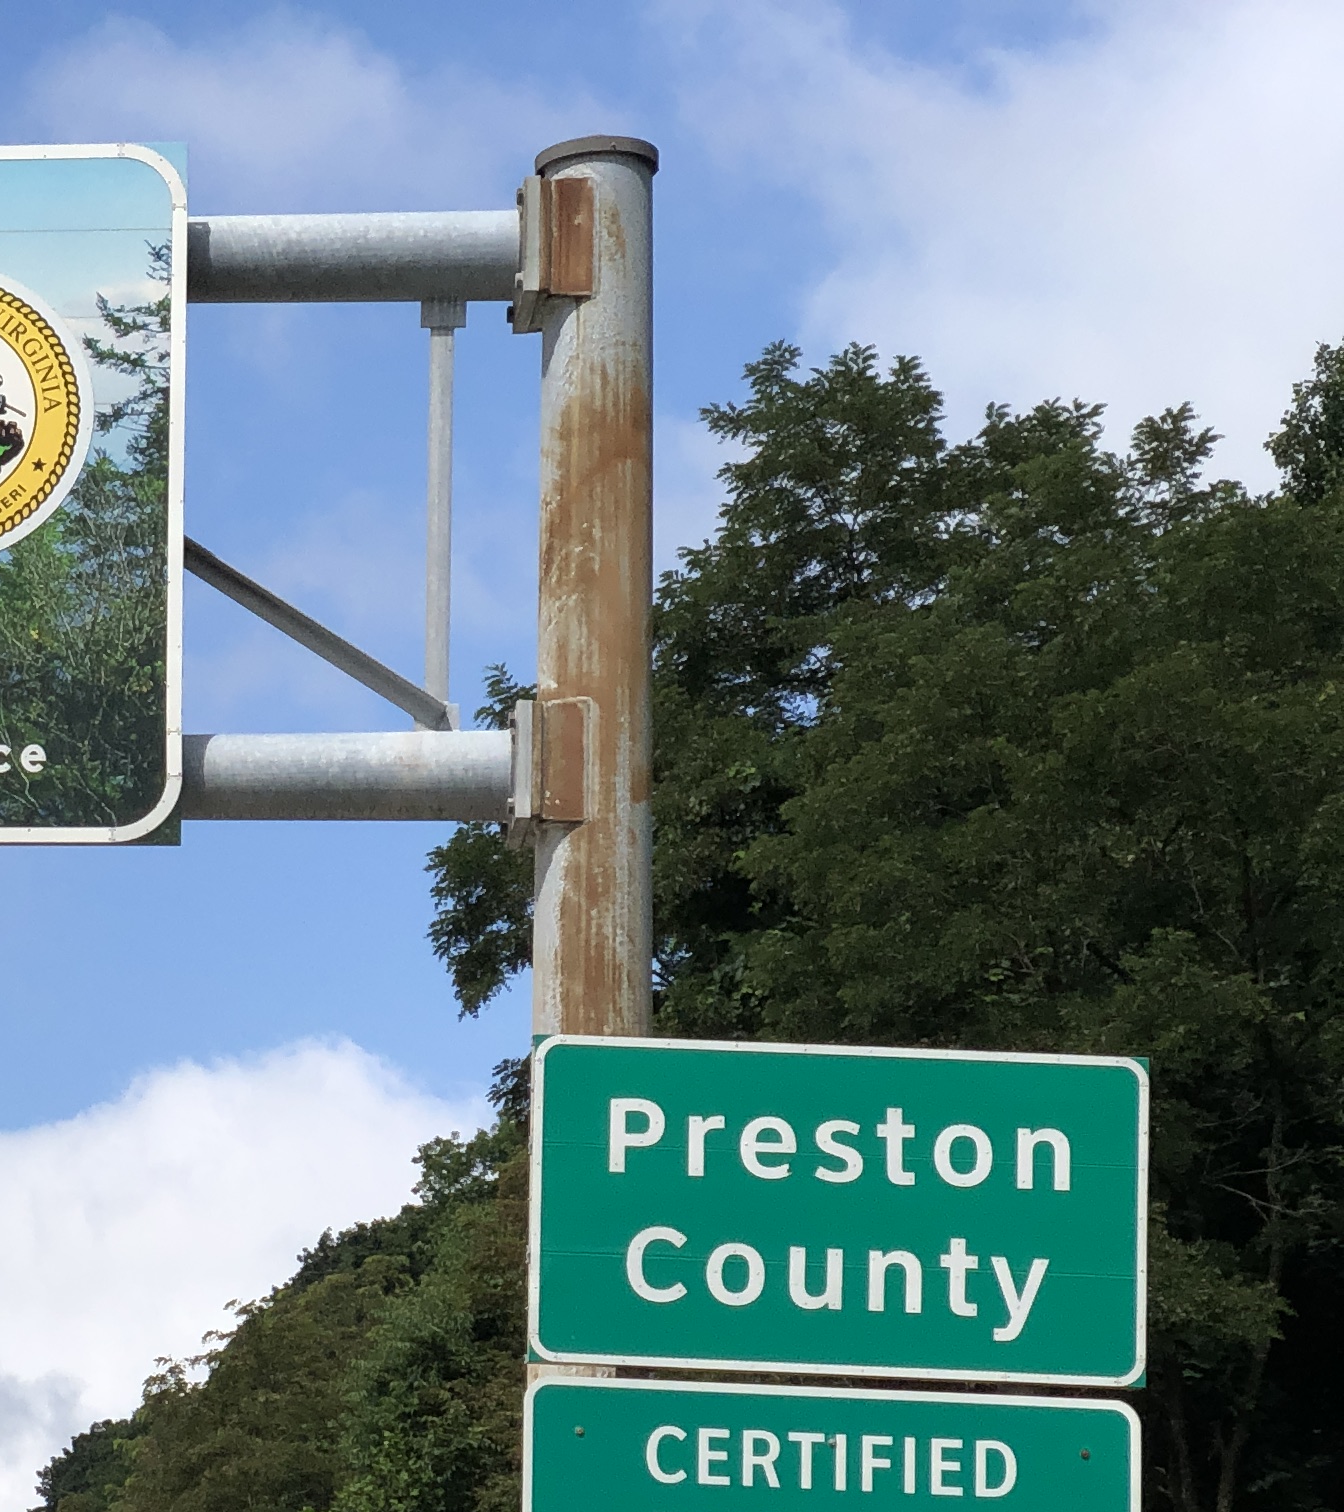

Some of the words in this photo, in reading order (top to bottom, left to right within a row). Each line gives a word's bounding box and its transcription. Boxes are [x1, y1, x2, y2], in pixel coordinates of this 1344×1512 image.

[608, 1097, 1072, 1192] Preston
[625, 1226, 1050, 1343] County
[645, 1425, 1018, 1498] CERTIFIED
